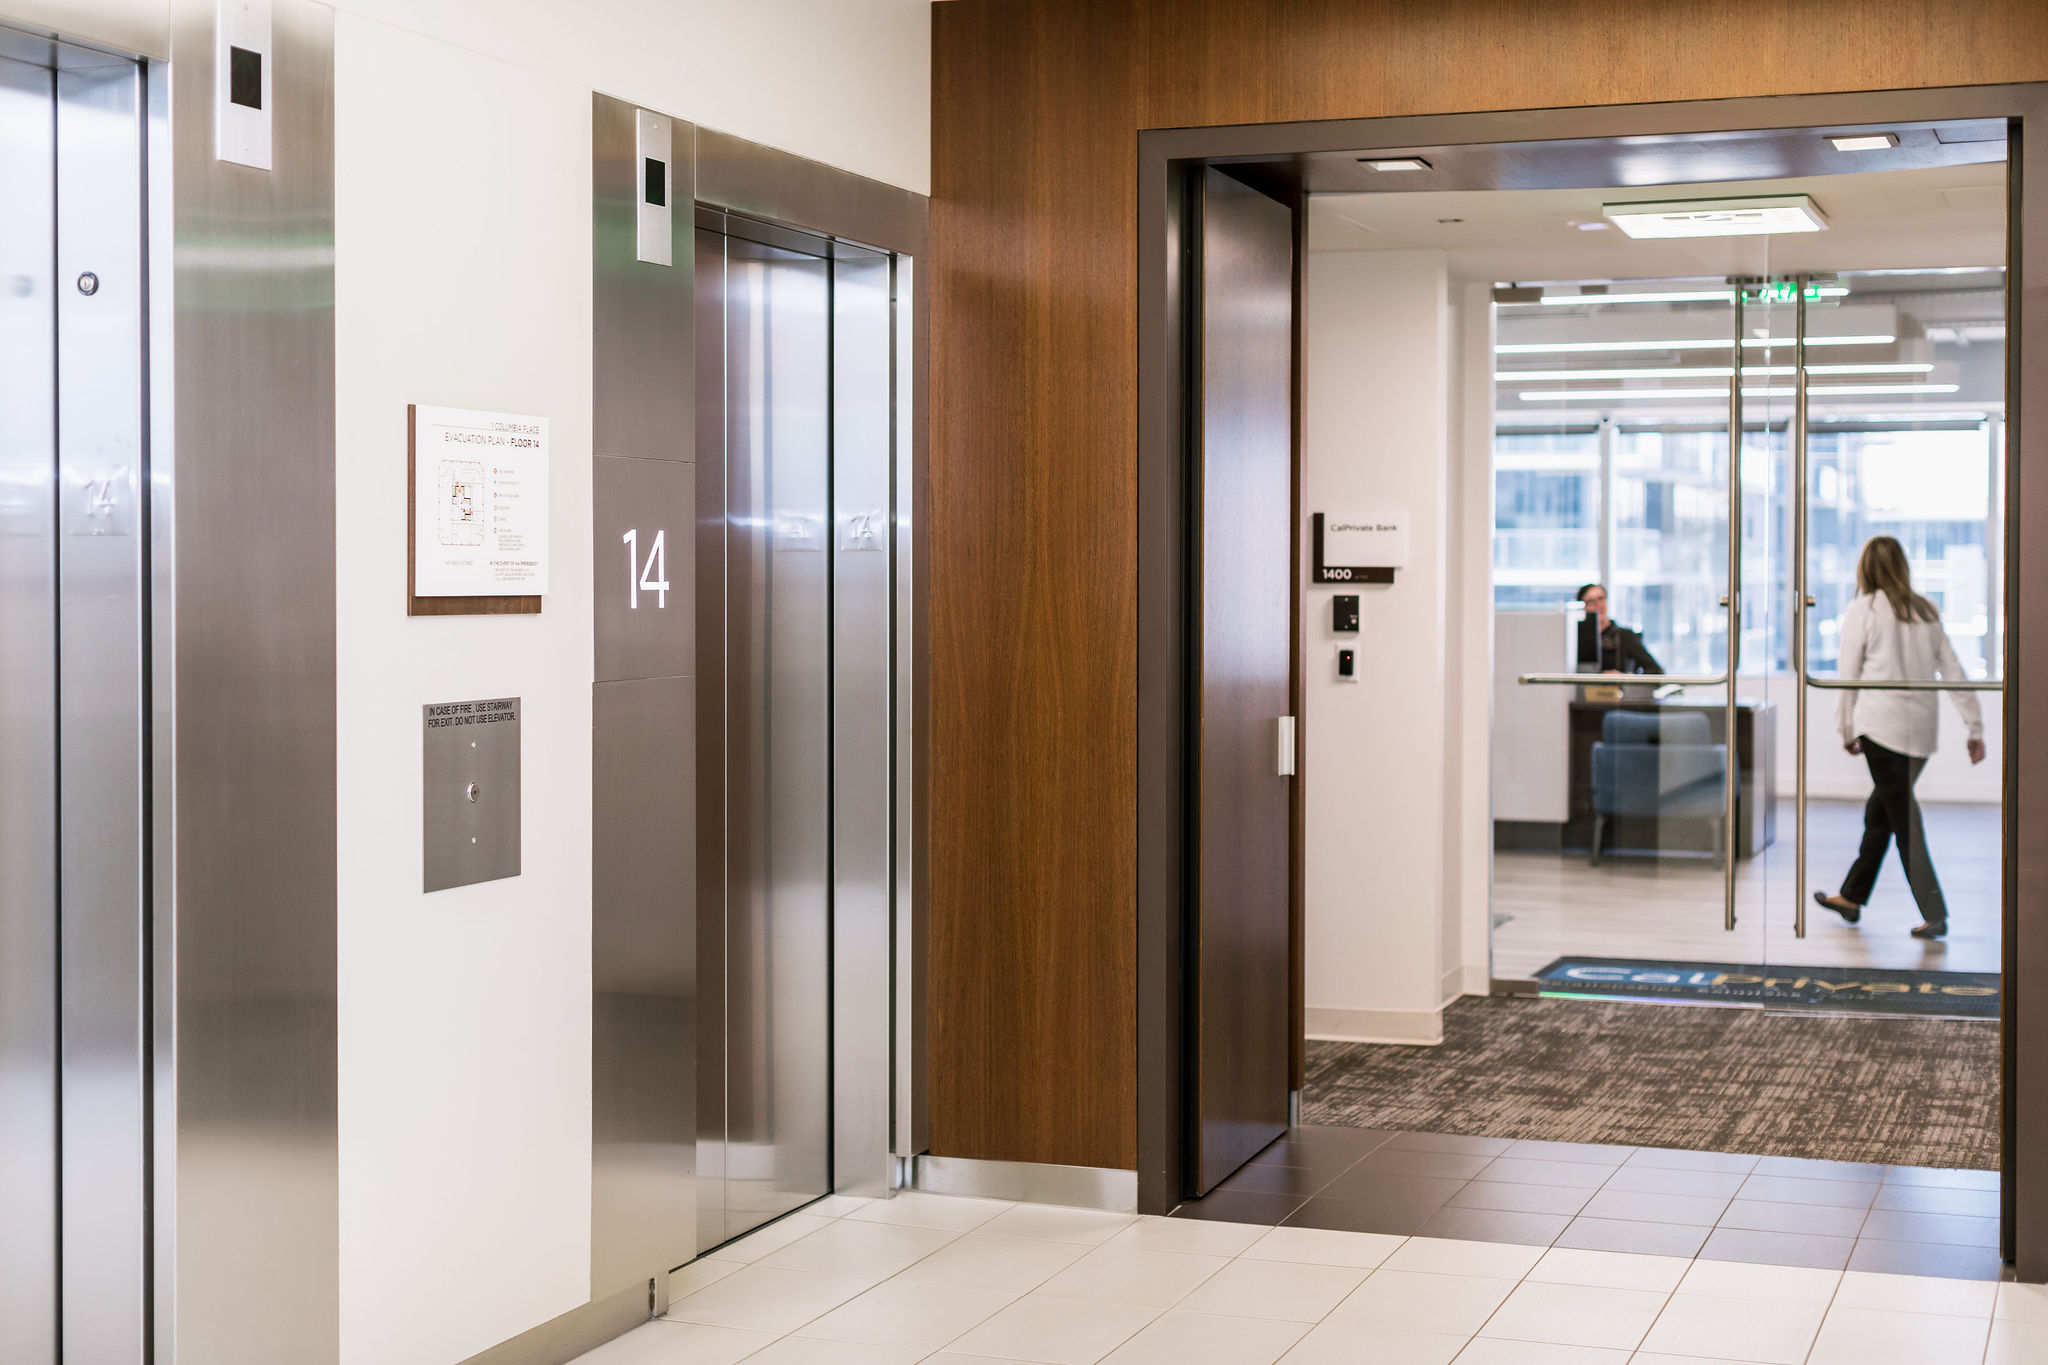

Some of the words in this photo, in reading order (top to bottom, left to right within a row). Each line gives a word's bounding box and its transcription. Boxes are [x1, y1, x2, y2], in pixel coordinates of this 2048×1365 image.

[495, 422, 521, 433] COLUMBIA
[523, 425, 539, 434] PLACE
[445, 432, 487, 444] EVACUATION
[488, 436, 505, 445] PLAN
[511, 438, 532, 448] FLOOR
[533, 440, 539, 448] 14
[84, 480, 115, 517] 14
[1330, 524, 1374, 533] CalPrivate
[1376, 524, 1397, 532] Bank
[622, 528, 670, 609] 14
[1322, 568, 1352, 580] 1400
[429, 707, 435, 716] IN
[436, 705, 451, 716] CASE
[452, 705, 459, 714] OF
[476, 703, 486, 713] USE
[487, 701, 513, 711] STAIRWAY
[428, 719, 440, 728] FOR
[455, 717, 463, 726] DO
[464, 715, 475, 725] NOT
[477, 714, 487, 724] USE
